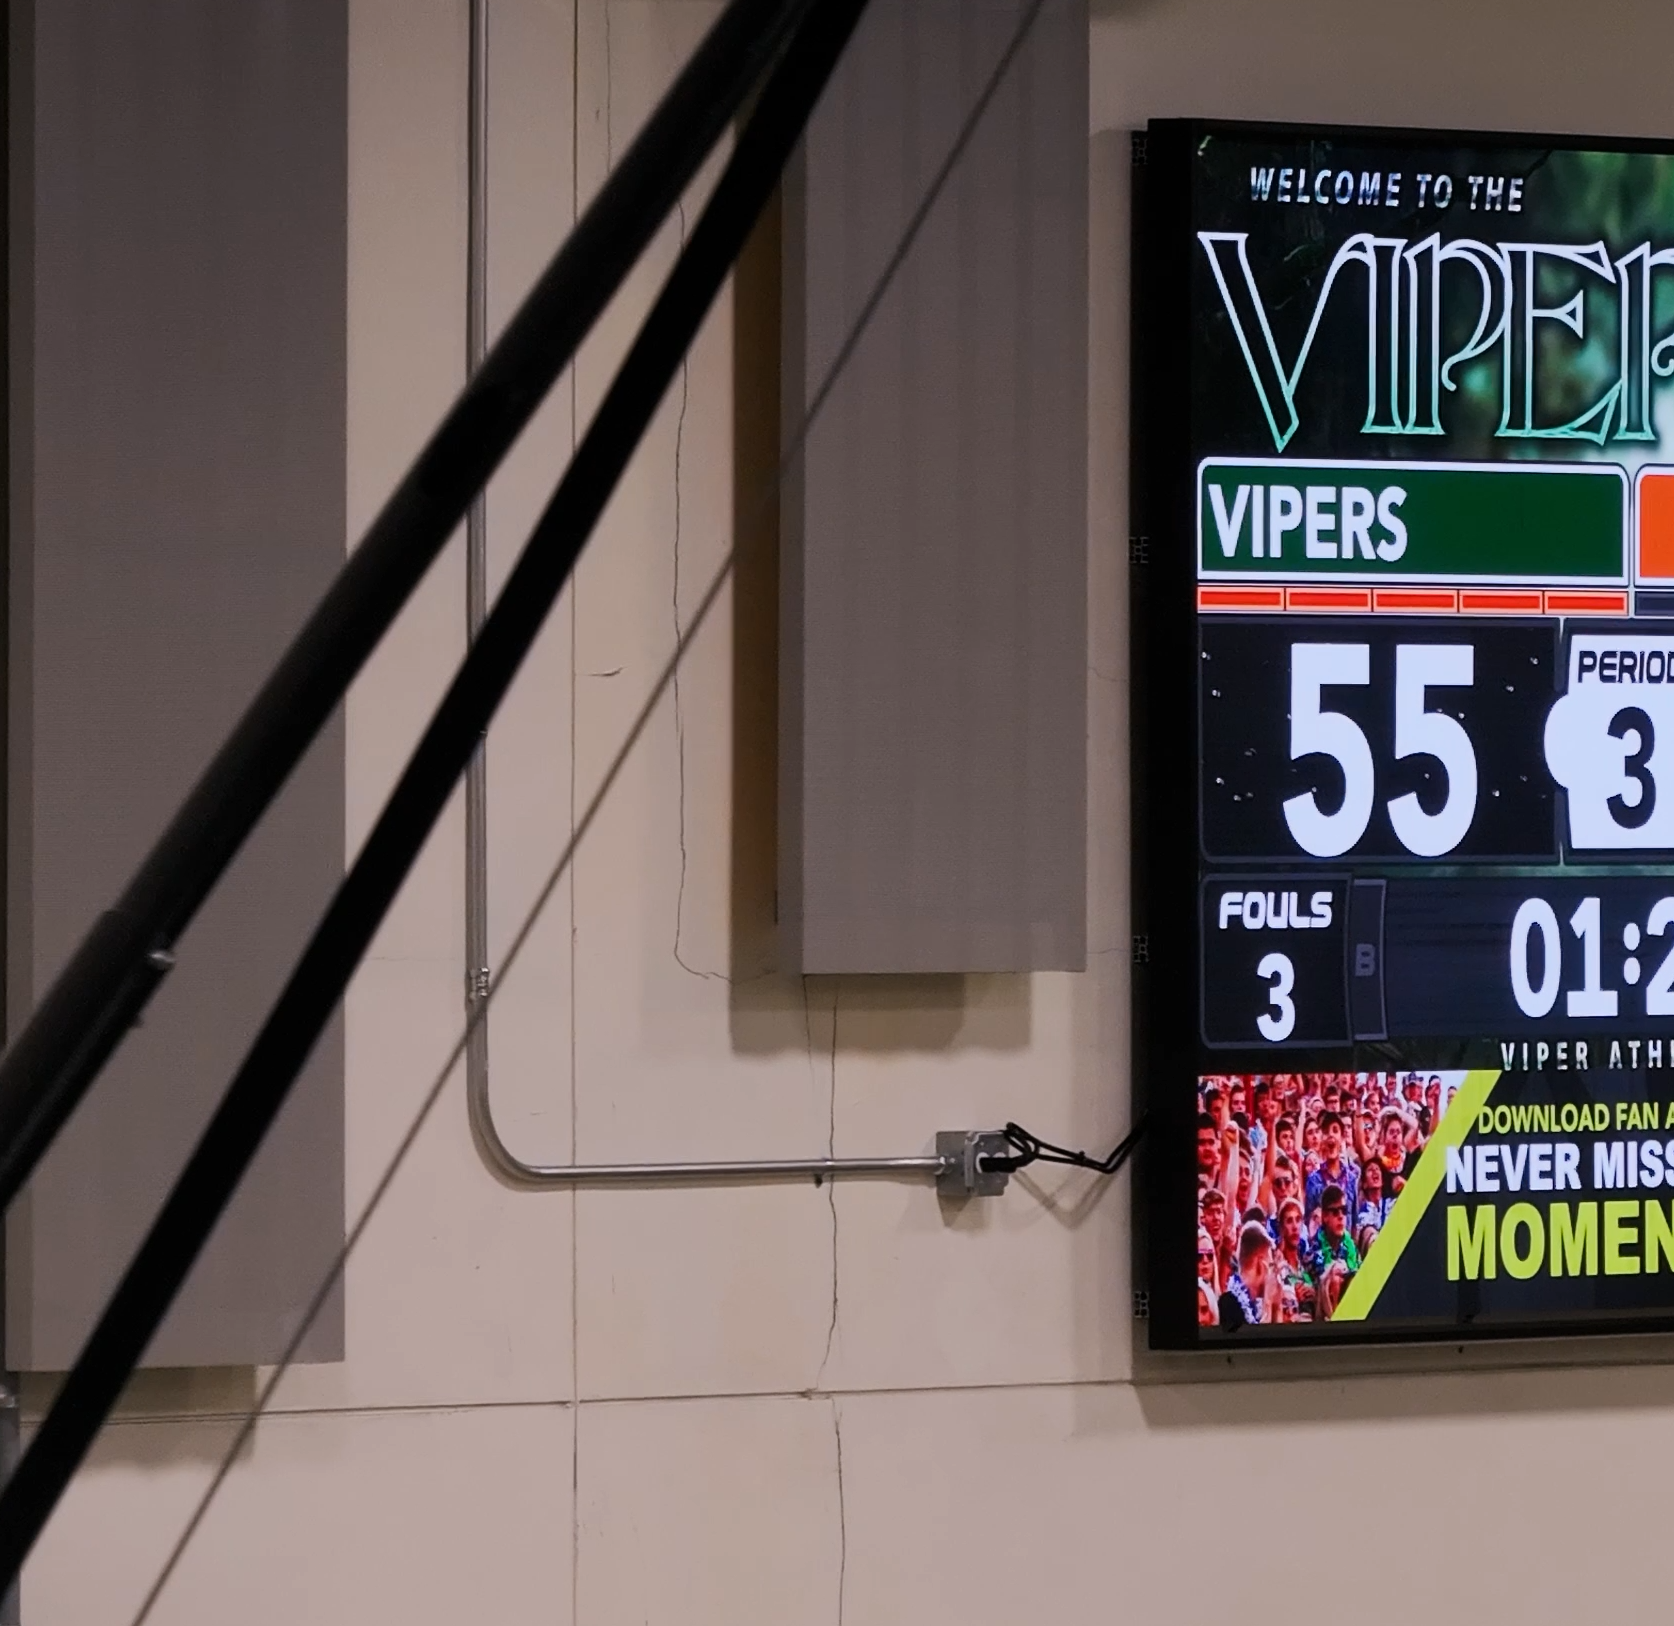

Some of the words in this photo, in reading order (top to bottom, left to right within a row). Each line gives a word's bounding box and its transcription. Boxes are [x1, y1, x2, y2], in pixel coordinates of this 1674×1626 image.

[1251, 167, 1401, 206] WELCOME
[1416, 174, 1452, 210] TO
[1467, 175, 1524, 213] THE
[1208, 484, 1408, 562] VIPERS
[1282, 643, 1478, 857] 55
[1606, 706, 1656, 830] 3
[1218, 891, 1333, 930] FOULS
[1356, 945, 1376, 976] B
[1256, 953, 1295, 1042] 3
[1501, 1041, 1589, 1072] VIPER
[1477, 1101, 1610, 1134] DOWNLOAD
[1615, 1101, 1660, 1131] FAN
[1445, 1142, 1581, 1192] NEVER
